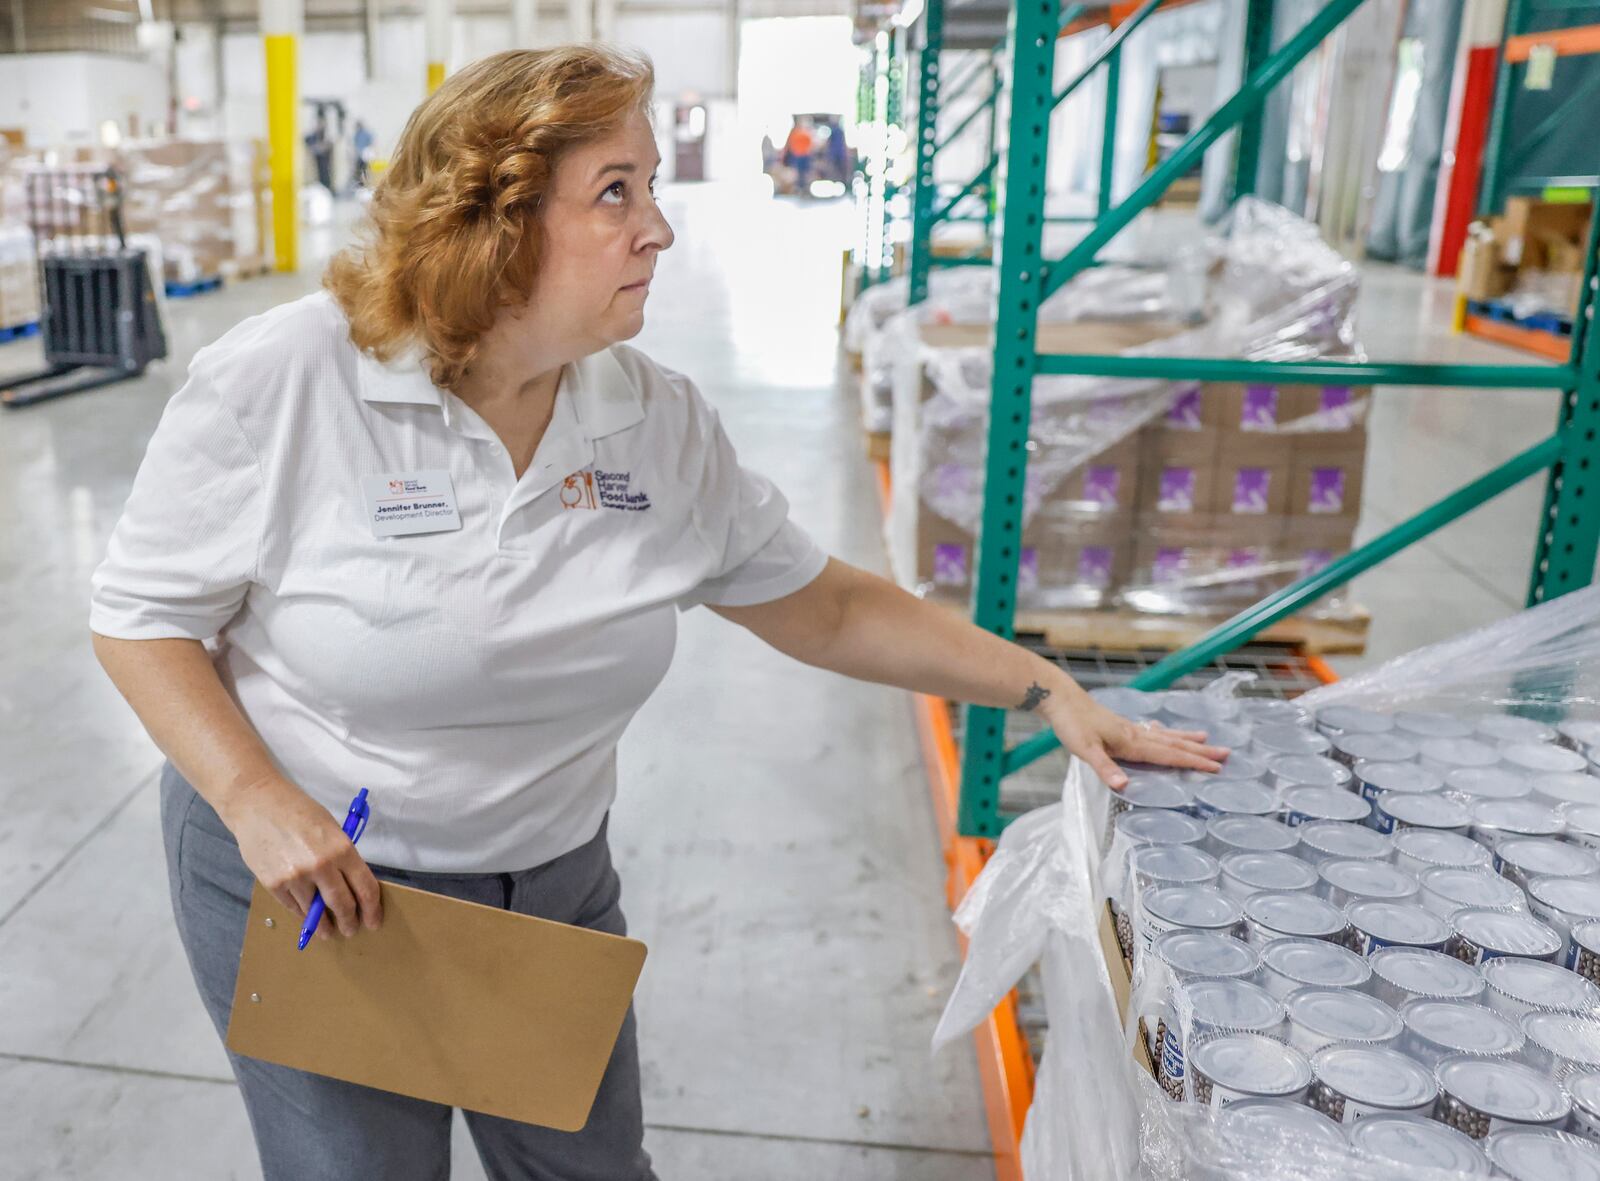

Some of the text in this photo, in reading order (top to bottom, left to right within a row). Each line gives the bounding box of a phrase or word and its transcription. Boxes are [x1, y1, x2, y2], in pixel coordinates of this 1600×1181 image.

[594, 470, 630, 482] Second
[600, 491, 624, 502] Food
[377, 503, 411, 513] Jennifer
[374, 508, 453, 522] Development Director
